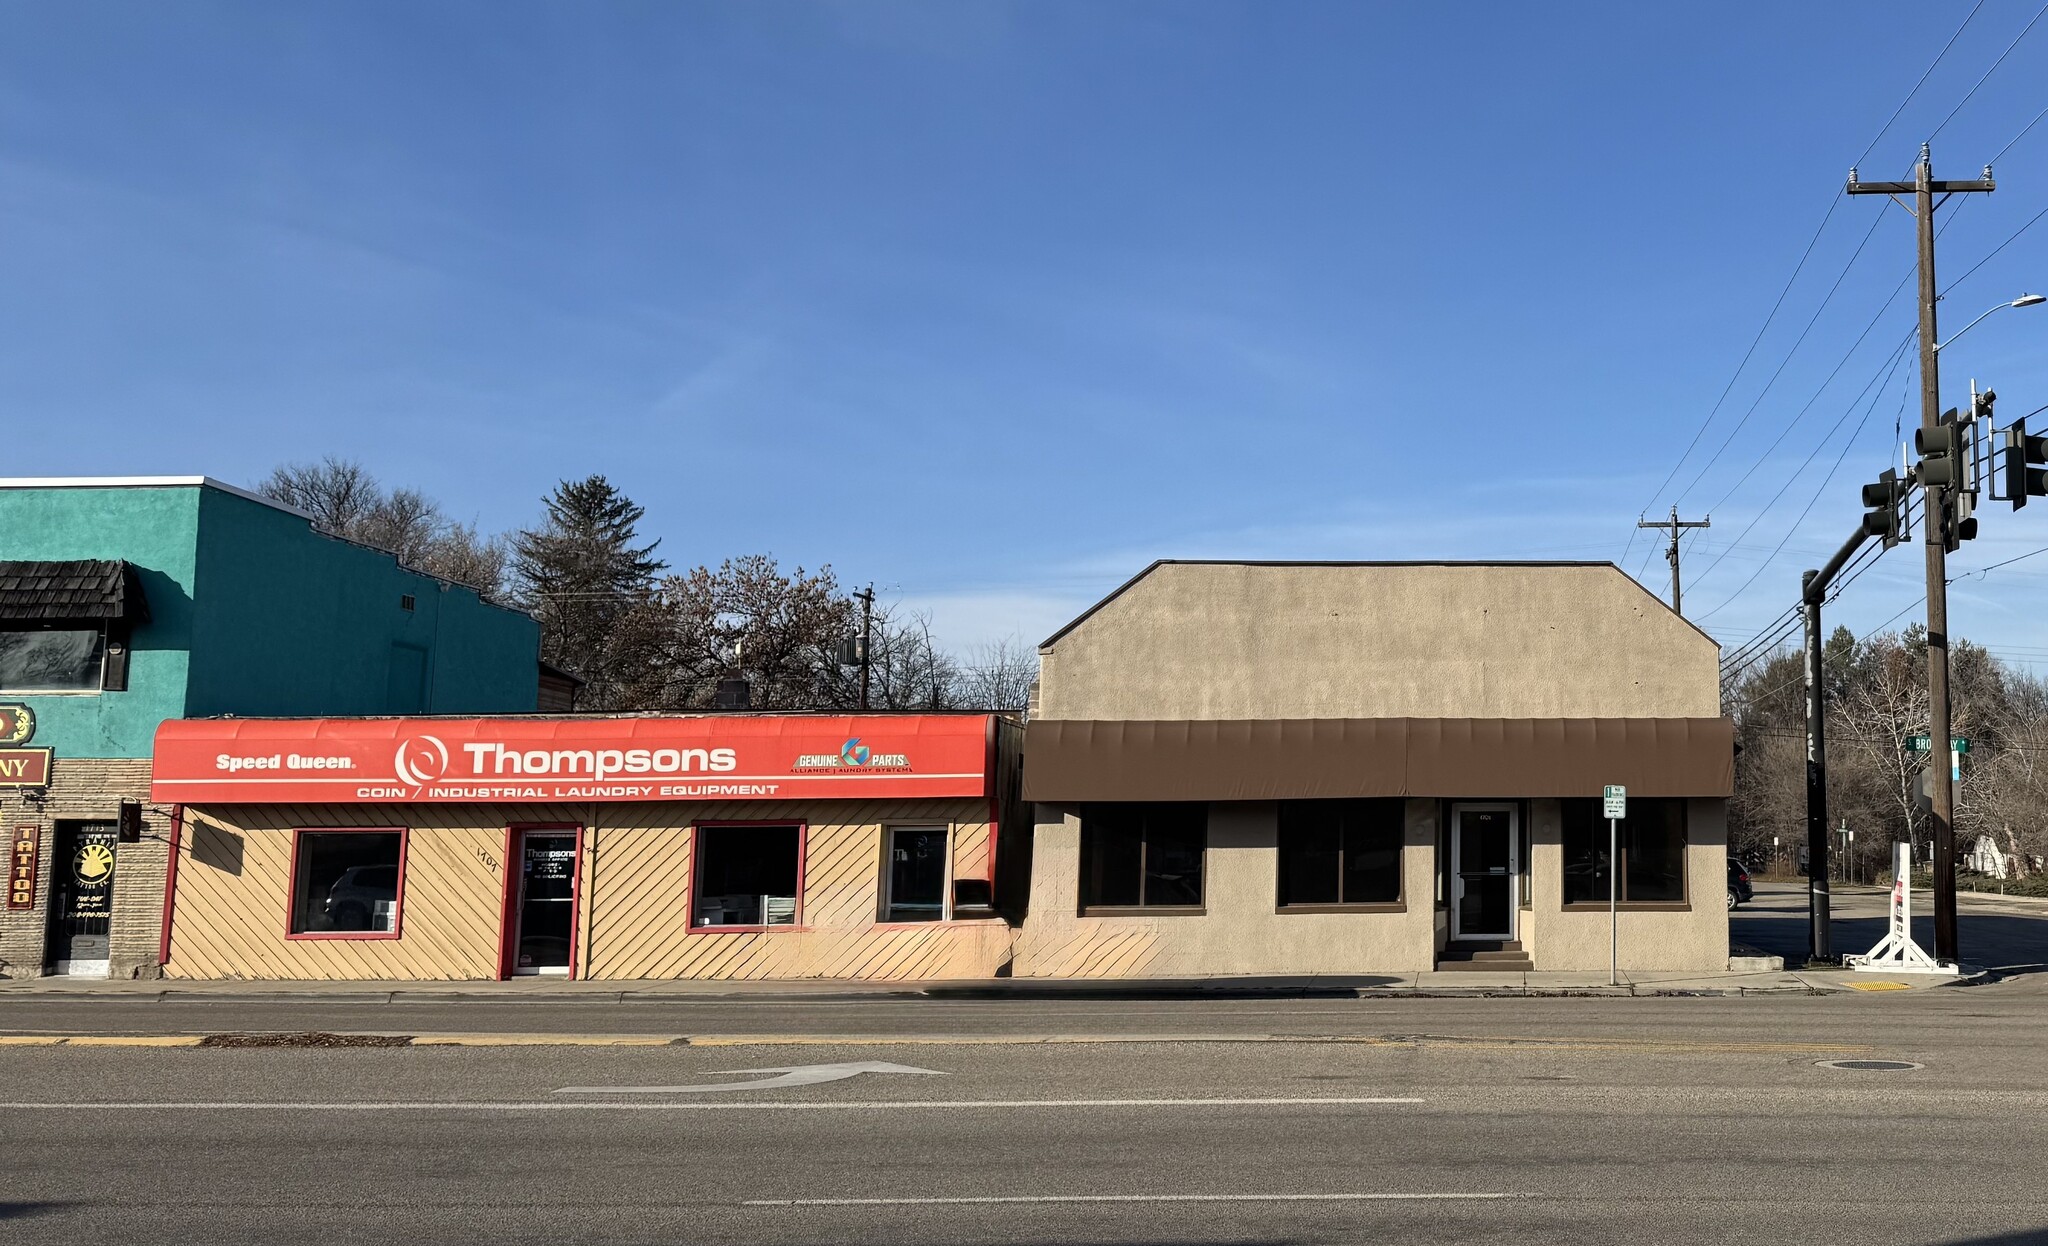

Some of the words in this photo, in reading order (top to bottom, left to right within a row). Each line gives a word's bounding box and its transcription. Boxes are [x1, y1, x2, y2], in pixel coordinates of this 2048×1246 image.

[216, 753, 281, 772] Speed
[463, 742, 737, 781] Thompsons
[799, 755, 838, 767] GENUINE
[872, 754, 905, 766] PARTS
[356, 787, 406, 798] COIN
[428, 786, 549, 798] INDUSTRIAL
[554, 786, 654, 797] LAUNDRY
[659, 784, 779, 796] EQUIPMENT
[526, 848, 576, 858] Thompsons
[12, 827, 35, 903] TATTOO
